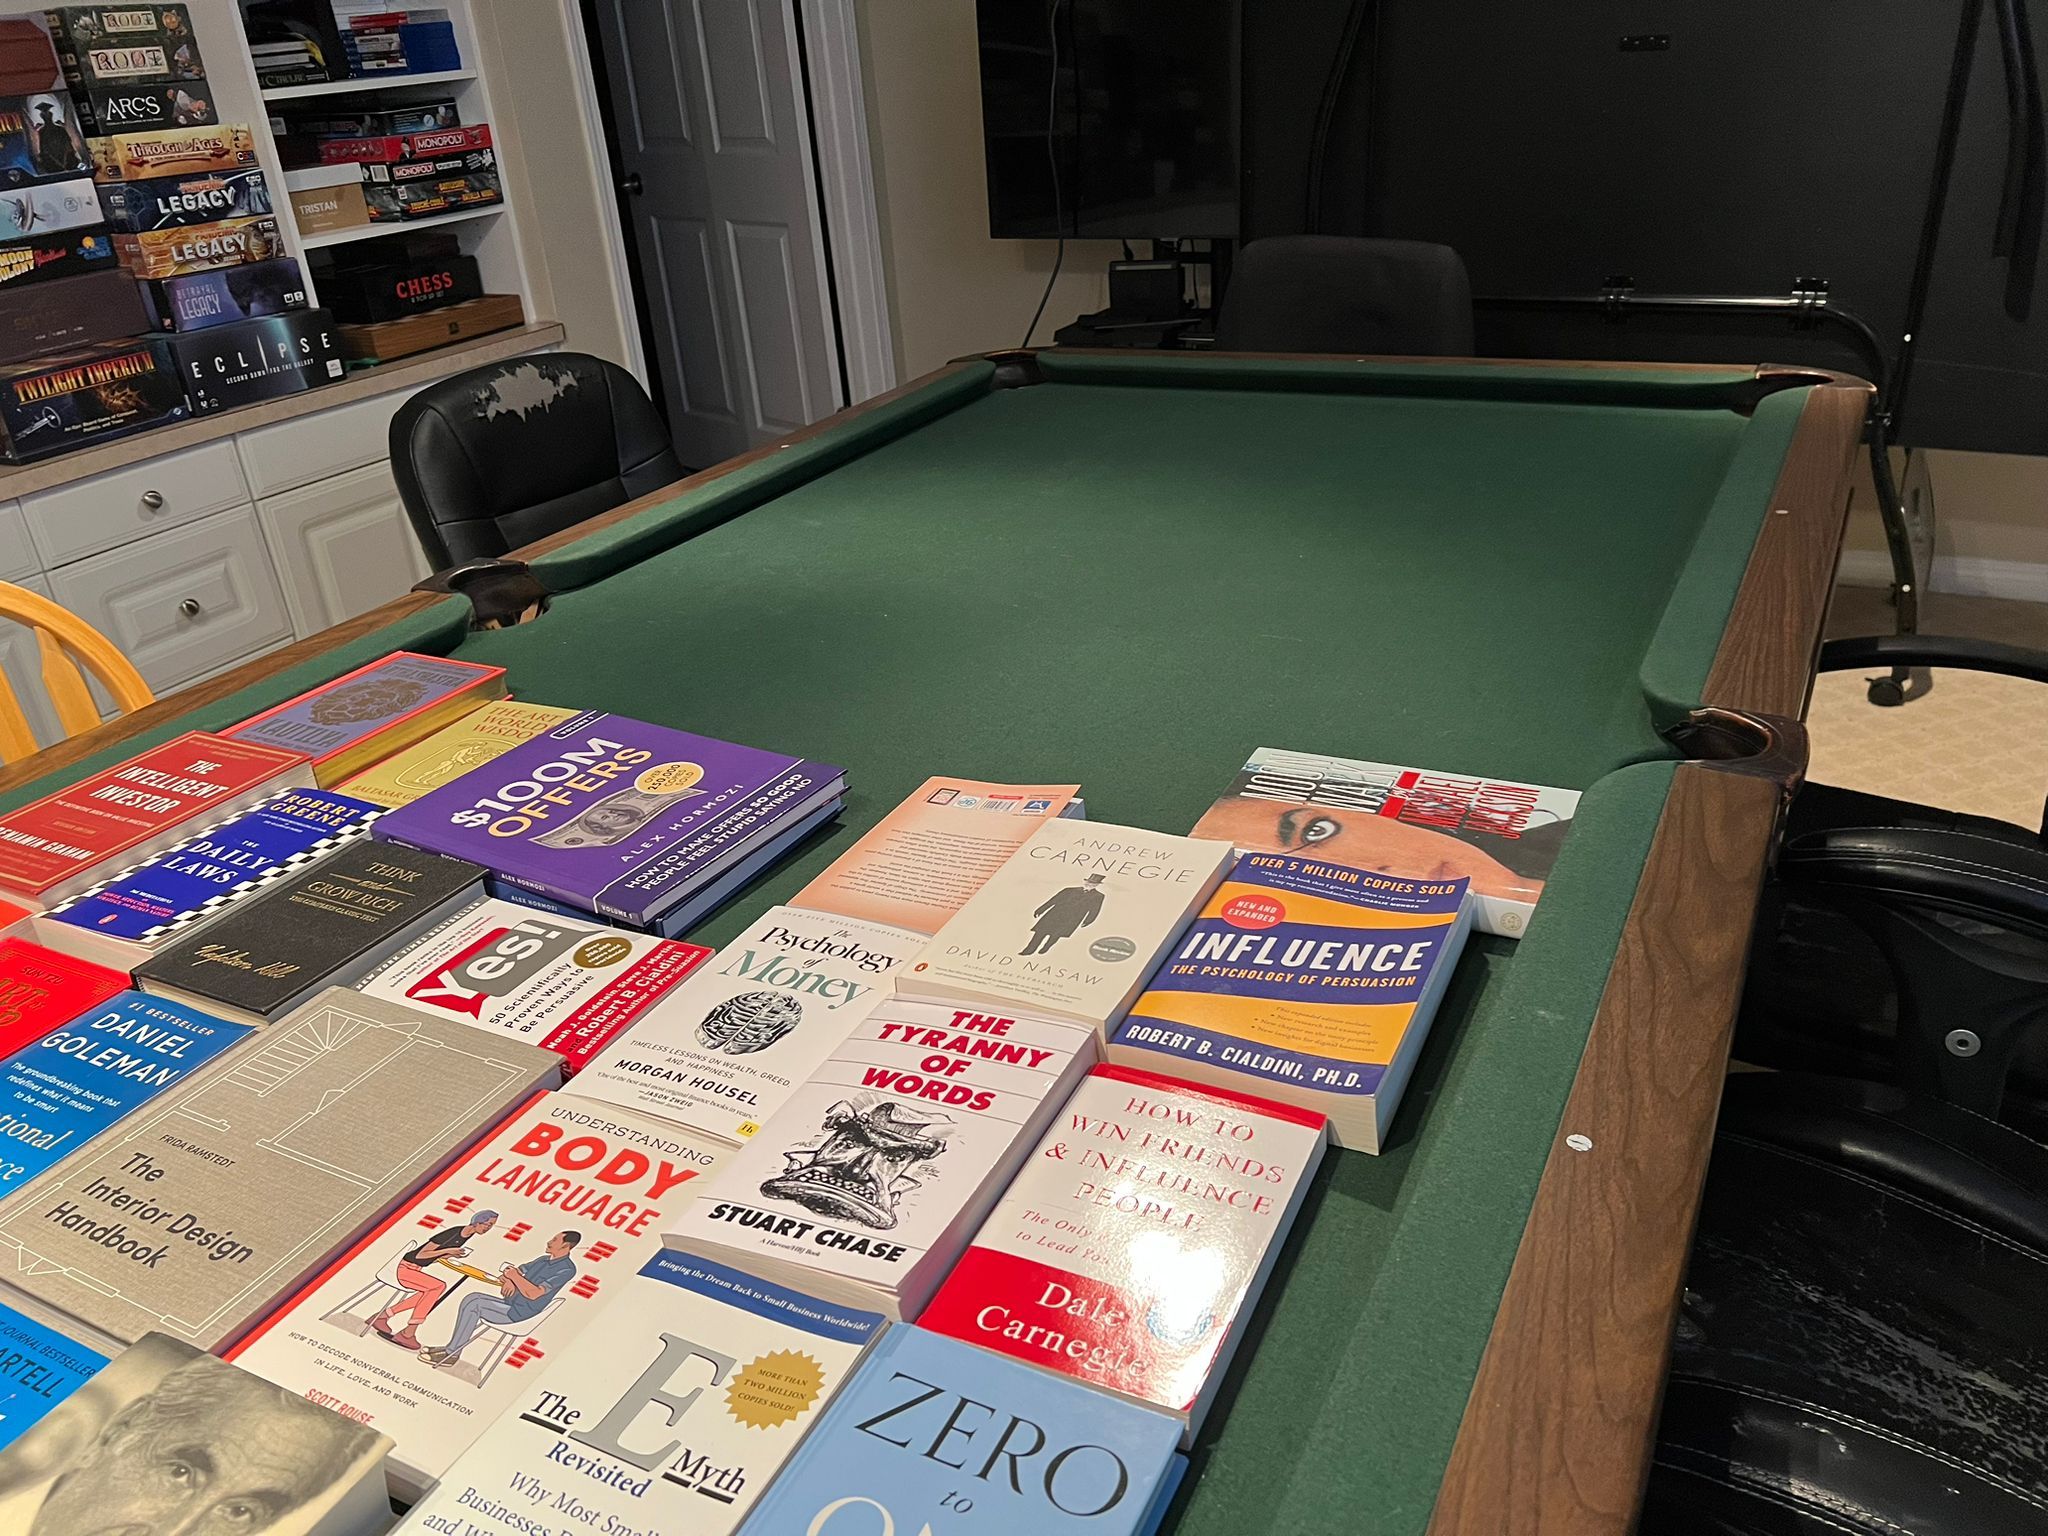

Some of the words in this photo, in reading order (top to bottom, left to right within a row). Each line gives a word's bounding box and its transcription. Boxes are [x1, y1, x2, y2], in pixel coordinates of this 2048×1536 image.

[103, 12, 154, 27] ROOT
[91, 49, 162, 71] ROOT
[106, 96, 161, 120] ARCS
[126, 141, 183, 158] THROUGH
[192, 137, 222, 151] AGES
[417, 134, 463, 149] MONOPOLY
[395, 164, 434, 177] MONOPOLY
[156, 186, 236, 214] LEGACY
[299, 200, 338, 215] TRISTAN
[171, 234, 246, 262] LEGACY
[176, 284, 216, 299] BETRAYAL
[178, 293, 222, 320] LEGACY
[395, 271, 454, 299] CHESS
[13, 369, 86, 402] TWILIGHT
[86, 352, 156, 385] IMPERIUM
[190, 332, 331, 380] ECLIPSE
[226, 373, 248, 385] SECOND
[255, 718, 348, 746] KAUTILYA
[114, 765, 231, 799] INTELLIGENT
[184, 759, 223, 775] THE
[449, 737, 624, 829] $100M
[89, 784, 182, 814] INVESTOR
[270, 801, 346, 828] GREENE
[283, 794, 360, 818] ROBERT
[487, 747, 653, 838] OFFERS
[1397, 775, 1483, 830] MICHAEL
[1461, 782, 1541, 840] JACKSON
[620, 833, 666, 863] ALEX
[669, 783, 745, 831] HORMOZI
[624, 863, 661, 889] HOW
[657, 854, 680, 869] TO
[677, 833, 713, 855] MAKE
[711, 806, 753, 835] OFFERS
[750, 795, 770, 809] SO
[767, 772, 804, 797] GOOD
[640, 860, 690, 891] PEOPLE
[686, 842, 720, 862] FEEL
[714, 815, 757, 845] STUPID
[756, 789, 797, 818] SAYING
[794, 777, 813, 791] NO
[162, 856, 239, 884] LAWS
[189, 840, 275, 871] DAILY
[1028, 844, 1197, 885] CARNEGIE
[1071, 836, 1176, 862] ANDREW
[365, 861, 423, 883] THINK
[1250, 856, 1284, 869] OVER
[1287, 861, 1299, 871] 5
[1302, 863, 1360, 884] MILLION
[1363, 876, 1414, 894] COPIES
[1418, 883, 1457, 896] SOLD
[307, 881, 361, 901] GROW
[359, 893, 404, 913] RICH
[1227, 909, 1276, 924] EXPANDED
[355, 973, 375, 991] NEW
[377, 954, 401, 973] YORK
[402, 936, 427, 955] TIMES
[429, 901, 481, 937] BESTSELLER
[410, 921, 564, 1000] Yes!
[757, 926, 906, 975] Psychology
[945, 945, 1013, 966] DAVID
[1022, 961, 1105, 986] NASAW
[1179, 930, 1433, 973] INFLUENCE
[20, 966, 43, 980] SUN
[44, 972, 65, 985] TZU
[488, 1012, 507, 1025] 50
[504, 961, 572, 1013] Scientifically
[575, 997, 628, 1037] Robert
[625, 986, 641, 999] B.
[635, 950, 686, 988] Cialdini
[717, 949, 877, 1010] Money
[1170, 964, 1199, 975] THE
[1200, 965, 1295, 983] PSYCHOLOGY
[1297, 974, 1318, 985] OF
[1321, 975, 1417, 988] PERSUASION
[128, 1001, 141, 1012] #1
[145, 1007, 216, 1036] BESTSELLER
[504, 996, 546, 1029] Proven
[542, 977, 574, 999] Ways
[570, 967, 584, 979] to
[519, 1019, 539, 1034] Be
[537, 975, 595, 1019] Persuasive
[90, 1012, 195, 1060] DANIEL
[948, 1010, 1016, 1036] THE
[40, 1031, 182, 1088] GOLEMAN
[630, 1039, 669, 1053] TIMELESS
[667, 1047, 708, 1063] LESSONS
[708, 1057, 722, 1066] ON
[721, 1060, 759, 1078] WEALTH,
[759, 1071, 792, 1088] GREED,
[876, 1022, 1056, 1069] TYRANNY
[918, 1054, 972, 1077] OF
[1125, 1024, 1196, 1050] ROBERT
[1196, 1042, 1214, 1058] B.
[1220, 1046, 1306, 1081] CIALDINI,
[1311, 1067, 1363, 1089] PH.D.
[614, 1058, 689, 1083] MORGAN
[688, 1076, 759, 1106] HOUSEL
[861, 1067, 997, 1112] WORDS
[550, 1106, 715, 1167] UNDERSTANDING
[1123, 1096, 1203, 1129] HOW
[1210, 1120, 1255, 1143] TO
[119, 1151, 166, 1183] The
[159, 1133, 190, 1149] FRIDA
[186, 1143, 236, 1169] RAMSTEDT
[509, 1121, 700, 1202] BODY
[1071, 1114, 1132, 1142] WIN
[1139, 1135, 1286, 1185] FRIENDS
[475, 1157, 662, 1238] LANGUAGE
[1045, 1142, 1071, 1161] &
[1078, 1149, 1277, 1217] INFLUENCE
[80, 1176, 172, 1227] Interior
[169, 1214, 255, 1265] Design
[1020, 1209, 1052, 1226] The
[1054, 1217, 1093, 1240] Only
[1073, 1181, 1208, 1233] PEOPLE
[44, 1200, 169, 1270] Handbook
[707, 1203, 815, 1240] STUART
[814, 1229, 908, 1263] CHASE
[658, 1259, 692, 1276] Bringing
[690, 1268, 705, 1279] the
[704, 1273, 732, 1290] Dream
[732, 1283, 753, 1297] Back
[752, 1290, 763, 1300] to
[761, 1294, 788, 1310] Small
[786, 1302, 823, 1321] Business
[822, 1312, 871, 1332] Worldwide!
[1035, 1280, 1126, 1329] Dale
[975, 1304, 1149, 1379] Carnegie
[742, 1378, 766, 1391] TWO
[765, 1384, 807, 1400] MILLION
[757, 1368, 784, 1381] MORE
[783, 1375, 809, 1387] THAN
[528, 1389, 582, 1427] The
[569, 1331, 739, 1471] E
[669, 1447, 748, 1496] Myth
[737, 1391, 769, 1406] COPIES
[768, 1400, 796, 1412] SOLD!
[853, 1370, 1129, 1518] ZERO
[544, 1440, 655, 1499] Revisited
[507, 1471, 552, 1506] Why
[550, 1491, 601, 1526] Most
[939, 1488, 975, 1515] to
